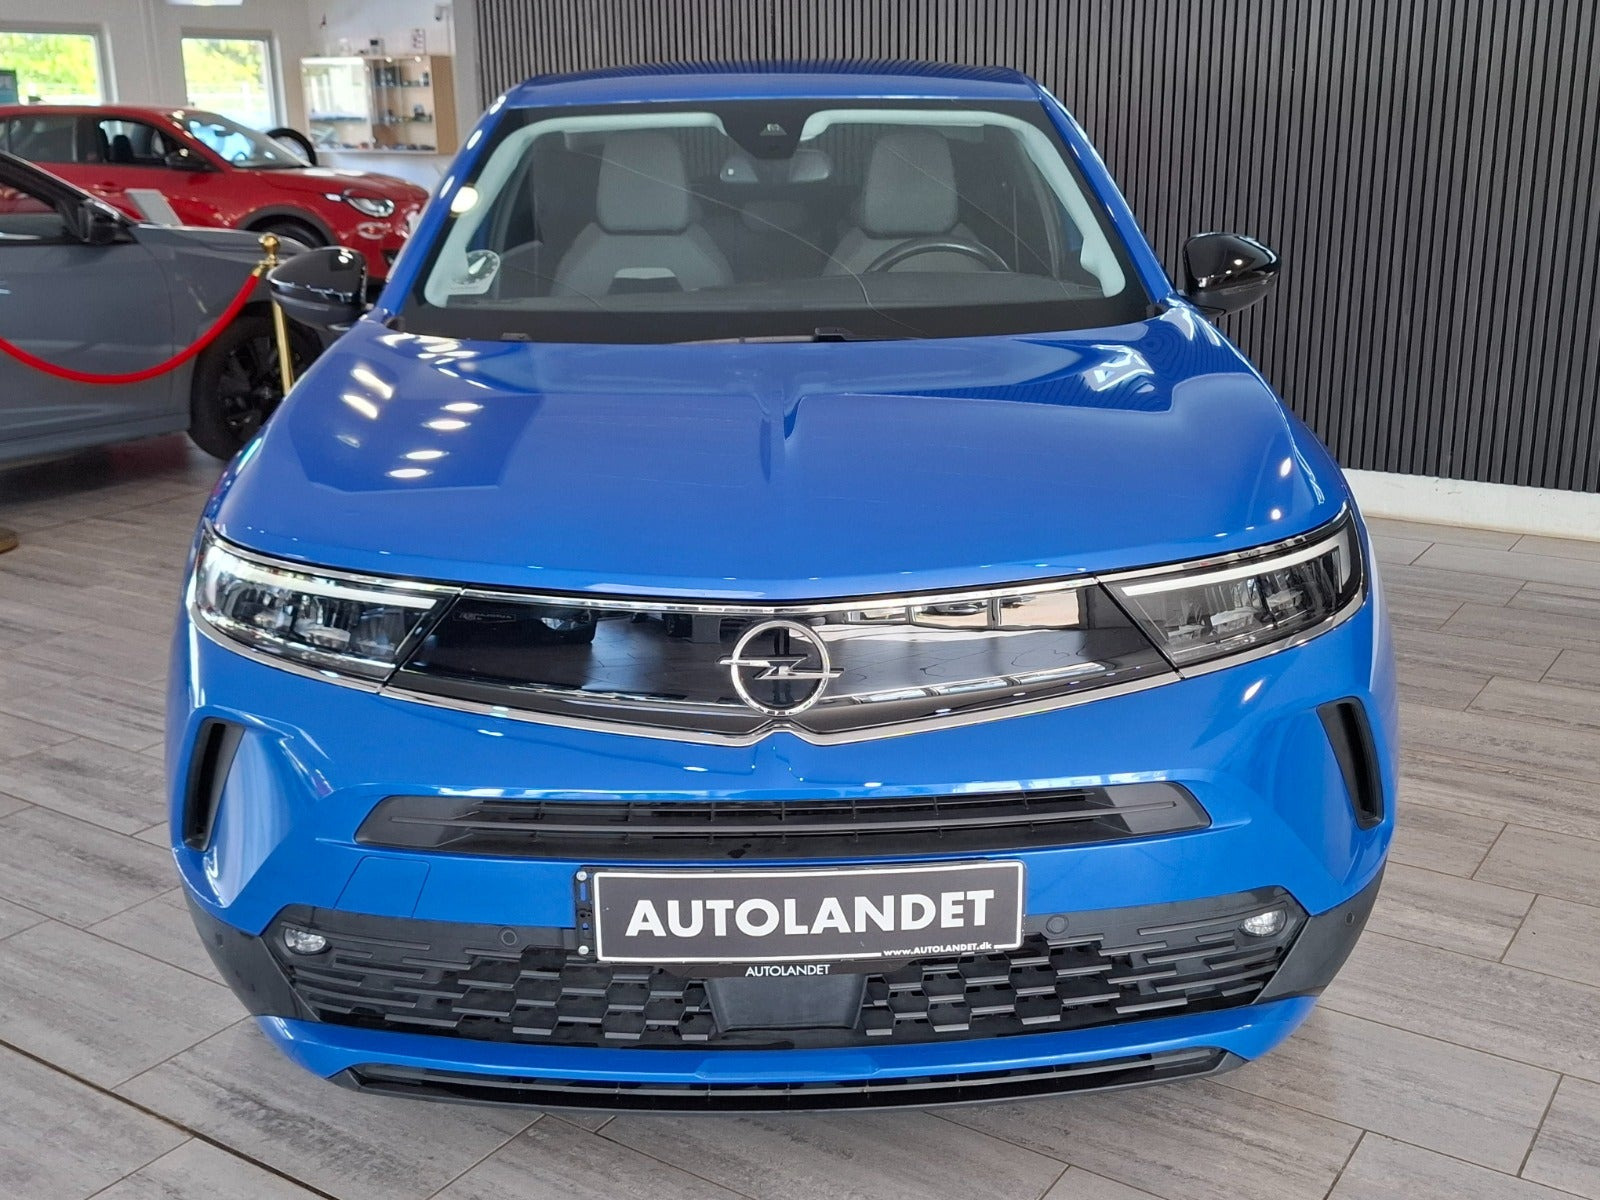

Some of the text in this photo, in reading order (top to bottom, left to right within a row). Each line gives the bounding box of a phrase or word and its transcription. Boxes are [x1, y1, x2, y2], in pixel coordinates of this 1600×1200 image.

[625, 890, 994, 937] AUTOLANDET
[883, 942, 992, 956] www.AUTOLANDET.dk
[745, 964, 830, 977] AUTOLANDET
